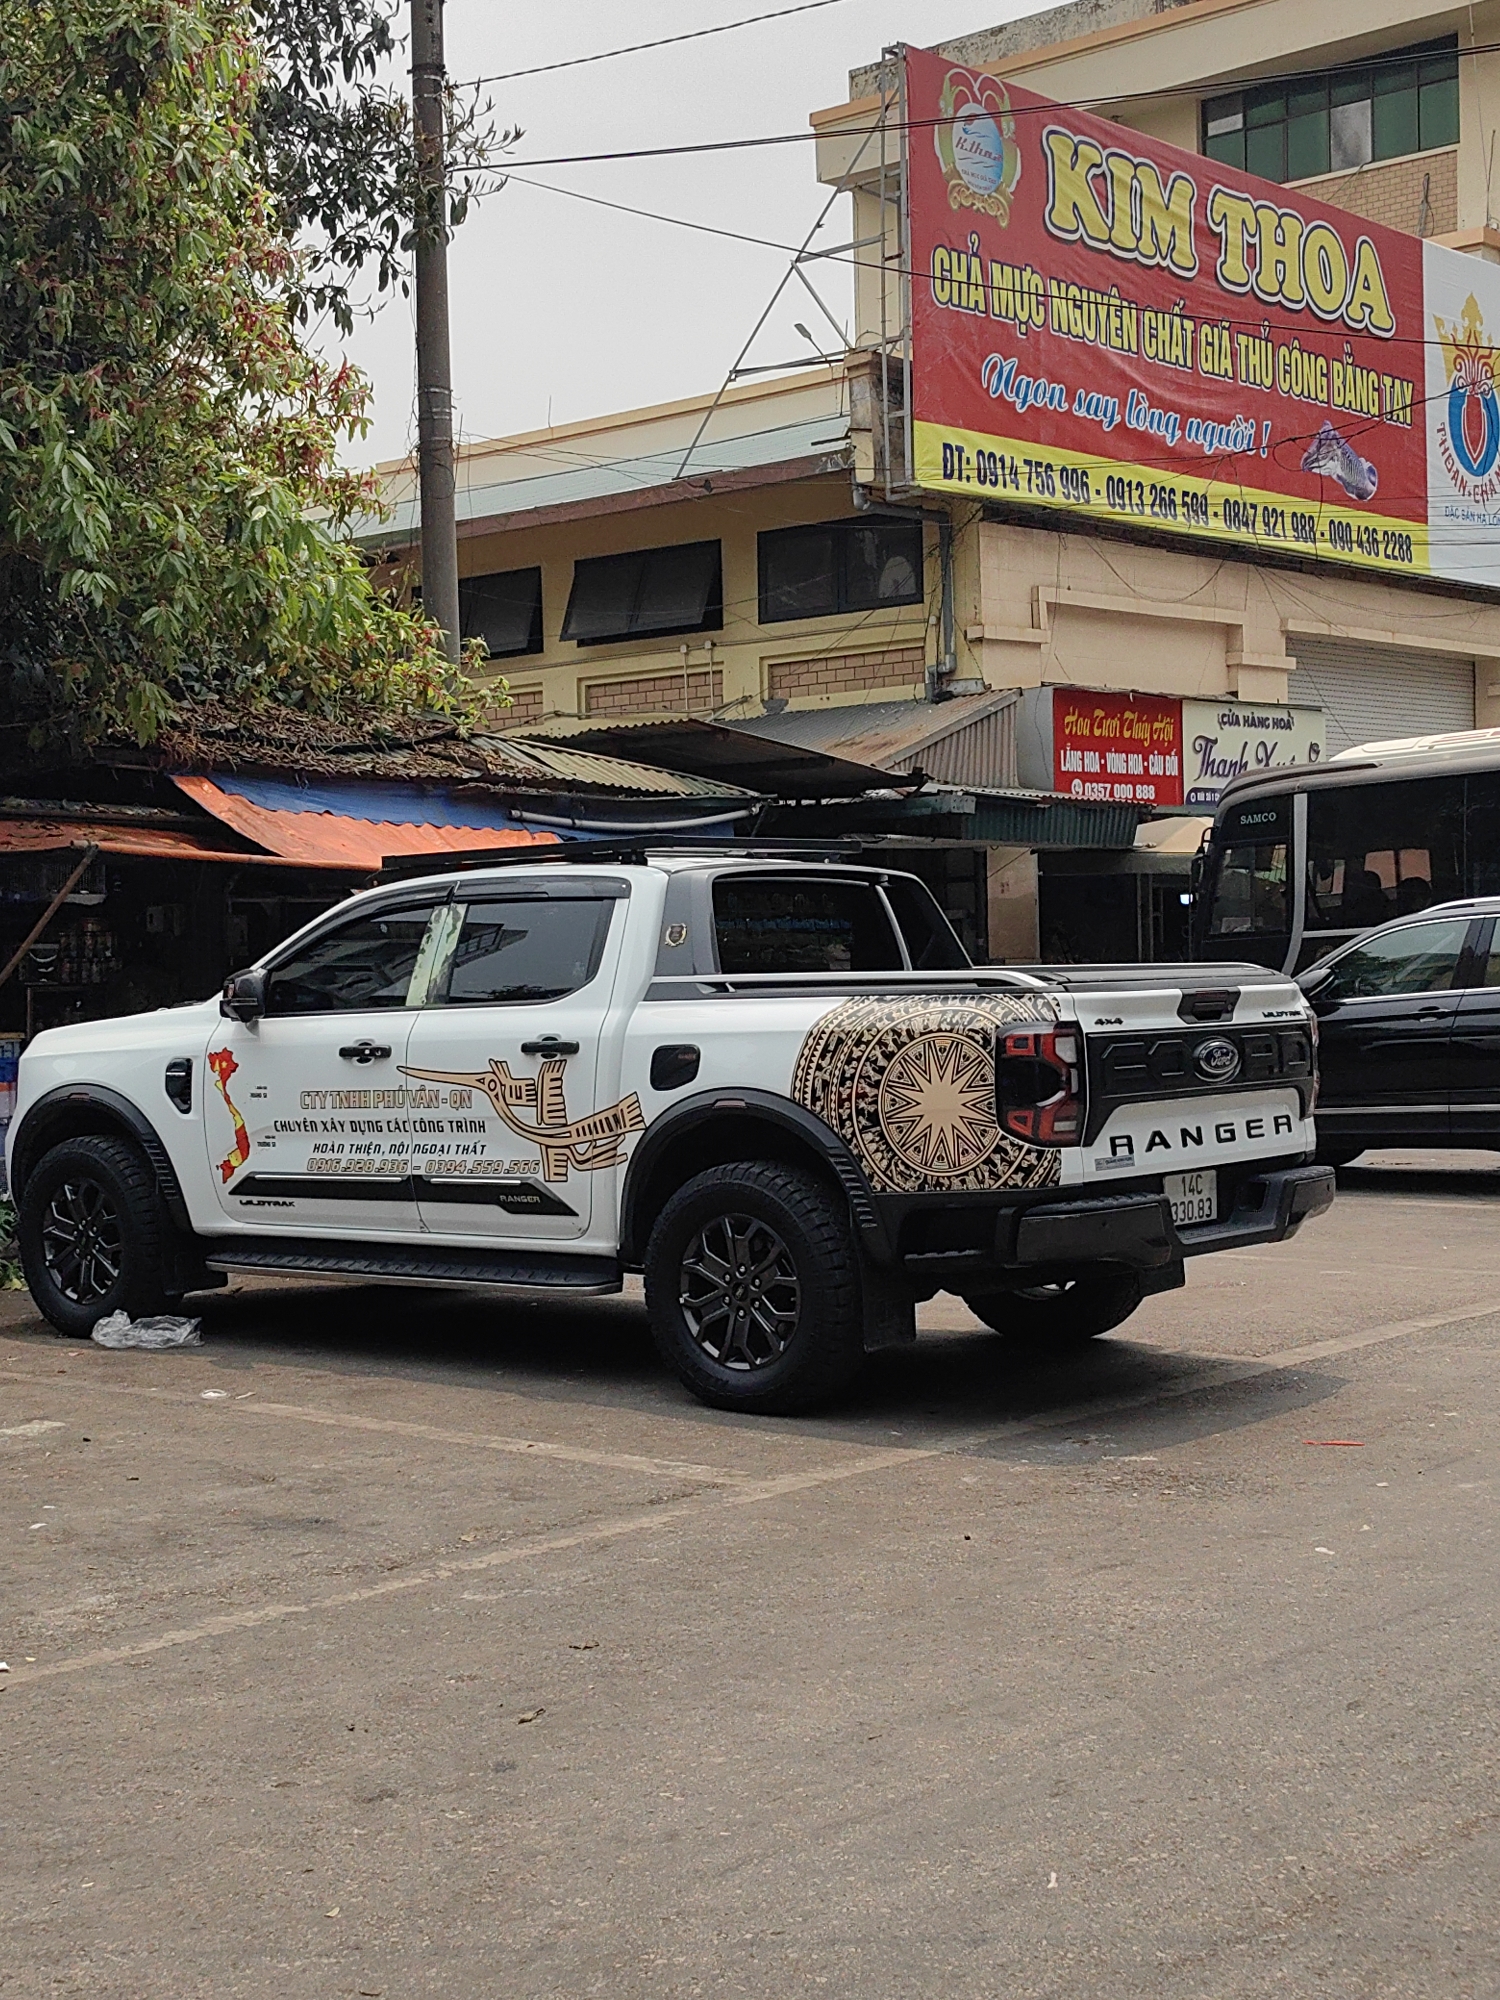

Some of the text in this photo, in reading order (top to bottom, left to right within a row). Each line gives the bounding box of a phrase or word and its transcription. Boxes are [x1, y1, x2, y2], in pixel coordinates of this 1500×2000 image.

[1045, 128, 1394, 335] KIM THOA
[932, 231, 1413, 427] CHẢ MỰC NGUYÊN CHẤT GIÃ THỦ CÔNG BẰNG TAY
[982, 353, 1068, 413] Ngon
[1073, 388, 1121, 431] say
[1126, 388, 1181, 446] lòng
[1186, 415, 1257, 454] người
[942, 442, 971, 483] ĐT:
[976, 449, 1020, 491] 0914
[1023, 459, 1056, 498] 756
[1059, 465, 1090, 504] 996
[1106, 475, 1145, 515] 0913
[1150, 484, 1177, 520] 266
[1181, 490, 1209, 526] 599
[1223, 498, 1258, 534] 0847
[1262, 505, 1287, 540] 921
[1291, 511, 1316, 544] 988
[1328, 518, 1354, 552] 090
[1356, 525, 1380, 558] 436
[1383, 530, 1413, 563] 2288
[1064, 706, 1090, 736] Hoa
[1093, 709, 1120, 737] Tươi
[1084, 750, 1100, 773] HOA
[1128, 753, 1144, 775] HOA
[1192, 735, 1249, 781] Thanh
[1084, 782, 1155, 800] 0357 000 888
[1240, 812, 1277, 825] SAMCO
[300, 1090, 329, 1109] CTY
[329, 1090, 371, 1109] TNHH
[372, 1085, 405, 1109] PHÚ
[406, 1085, 440, 1109] VÂN
[449, 1090, 473, 1111] QN
[274, 1117, 318, 1133] CHUYÊN
[322, 1117, 345, 1133] XÂY
[386, 1117, 409, 1133] CÁC
[413, 1117, 444, 1133] CÔNG
[447, 1117, 486, 1133] TRÌNH
[1109, 1114, 1293, 1156] RANGER
[313, 1141, 345, 1154] HOÀN
[388, 1141, 410, 1157] NỘI
[412, 1143, 451, 1157] NGOẠI
[455, 1140, 487, 1156] THẤT
[307, 1157, 409, 1173] 0916.928.936
[425, 1159, 540, 1175] 0394.559.566
[1181, 1174, 1203, 1197] 14C
[499, 1195, 541, 1203] RANGER
[1171, 1197, 1213, 1223] 330.83
